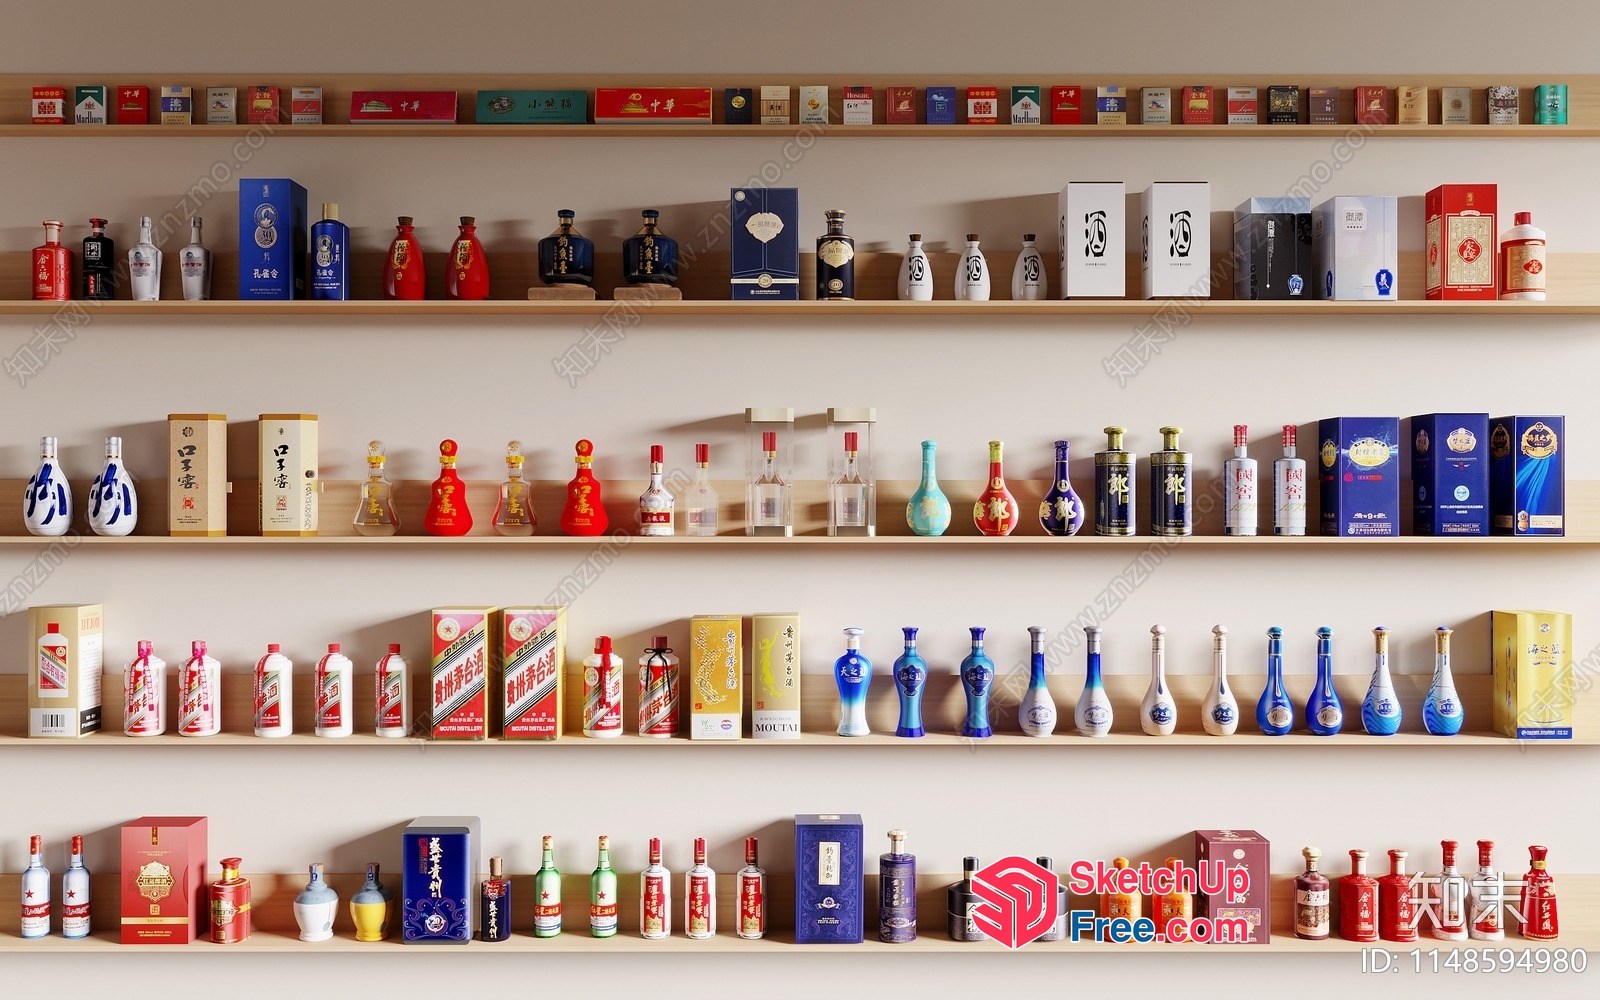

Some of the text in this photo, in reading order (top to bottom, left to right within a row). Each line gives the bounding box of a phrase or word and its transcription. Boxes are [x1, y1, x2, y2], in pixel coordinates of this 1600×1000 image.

[629, 93, 642, 101] 40
[76, 111, 104, 123] Marlboro
[1012, 111, 1040, 123] Marlboro
[177, 445, 198, 489] 口子窖
[273, 445, 290, 489] 口子窖
[755, 723, 798, 732] MOUTAI
